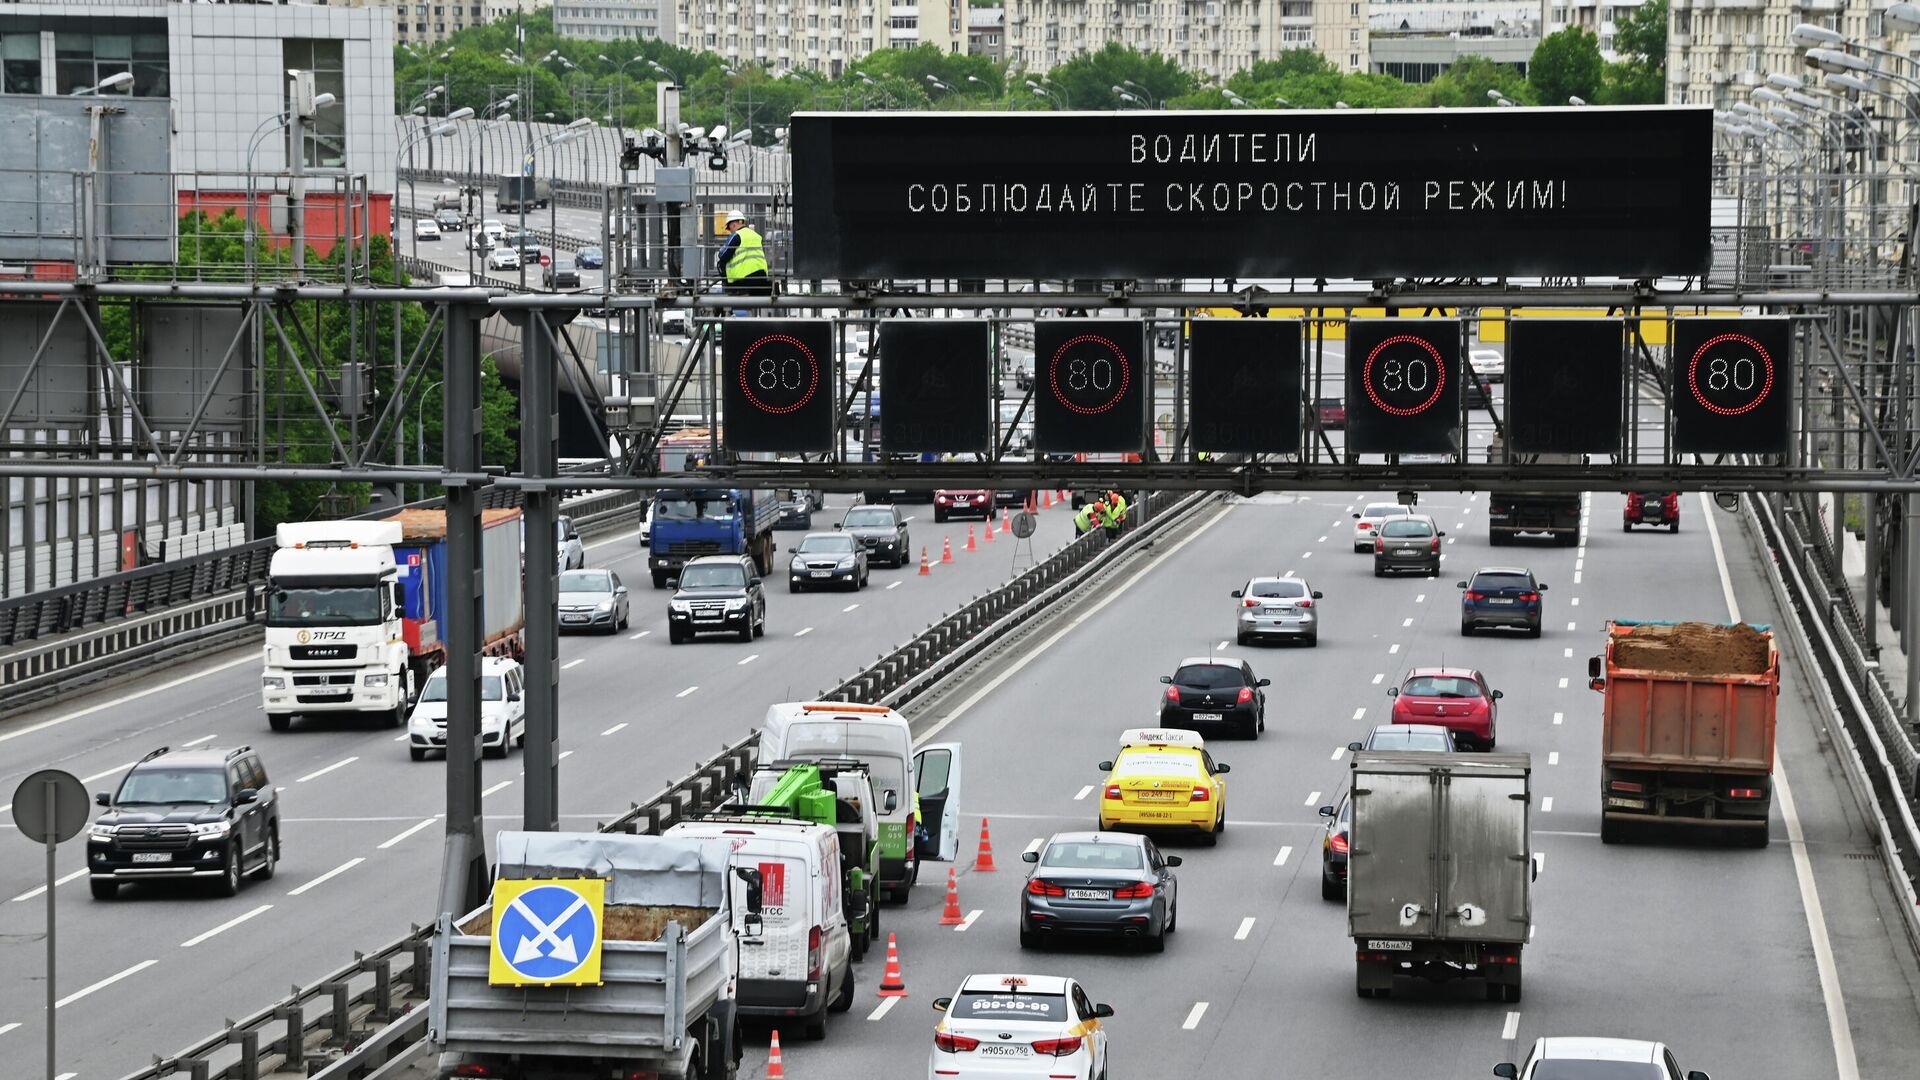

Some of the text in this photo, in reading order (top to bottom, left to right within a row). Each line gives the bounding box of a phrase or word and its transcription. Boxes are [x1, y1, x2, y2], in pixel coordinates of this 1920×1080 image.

[1131, 132, 1316, 164] ВОДИТЕЛИ
[908, 179, 1566, 213] СОБЛЮДАЙТЕ СКОРОСТНОЙ РЕЖИМ!
[758, 358, 801, 390] 80
[1068, 358, 1112, 390] 80
[1382, 359, 1428, 392] 80
[1707, 358, 1756, 391] 80
[1140, 732, 1184, 741] Яндекс Такси
[972, 1000, 1050, 1012] 999-99-99
